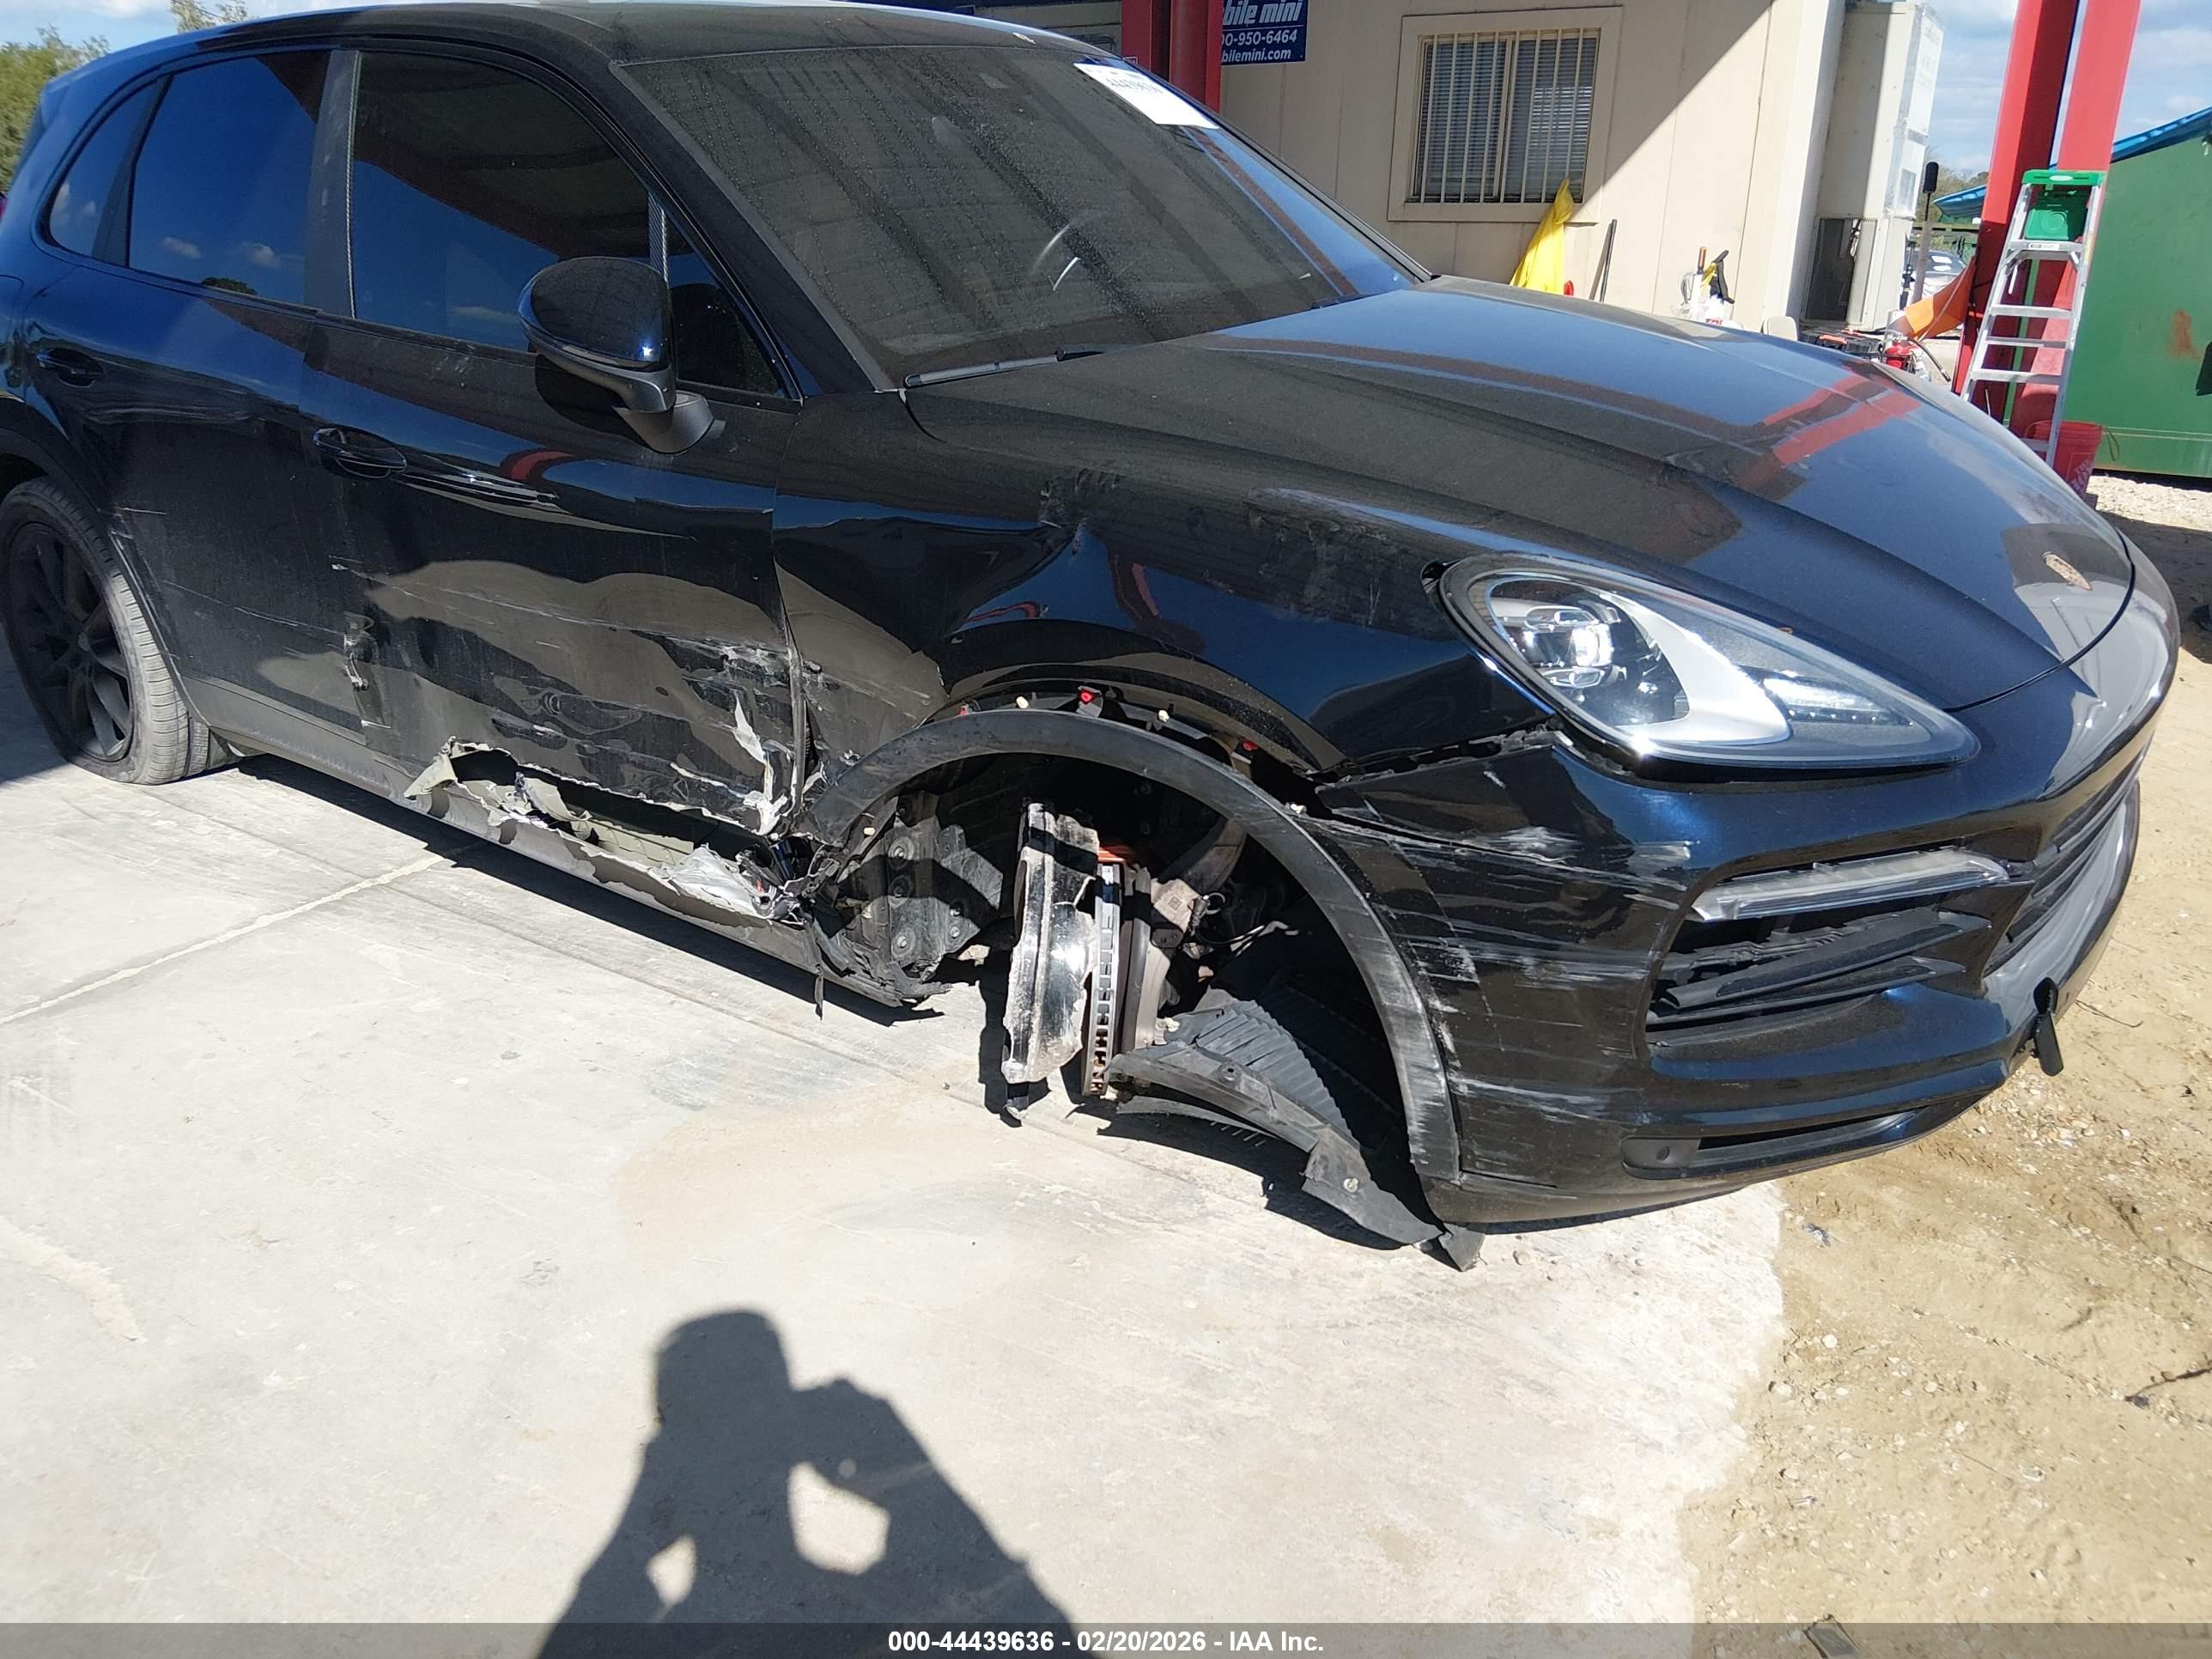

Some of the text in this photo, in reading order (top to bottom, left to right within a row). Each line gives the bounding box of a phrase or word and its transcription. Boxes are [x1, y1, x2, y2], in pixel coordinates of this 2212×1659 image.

[1222, 0, 1303, 26] bile mini
[1222, 28, 1298, 46] 0-950-6464
[1221, 47, 1291, 63] bilemini.com
